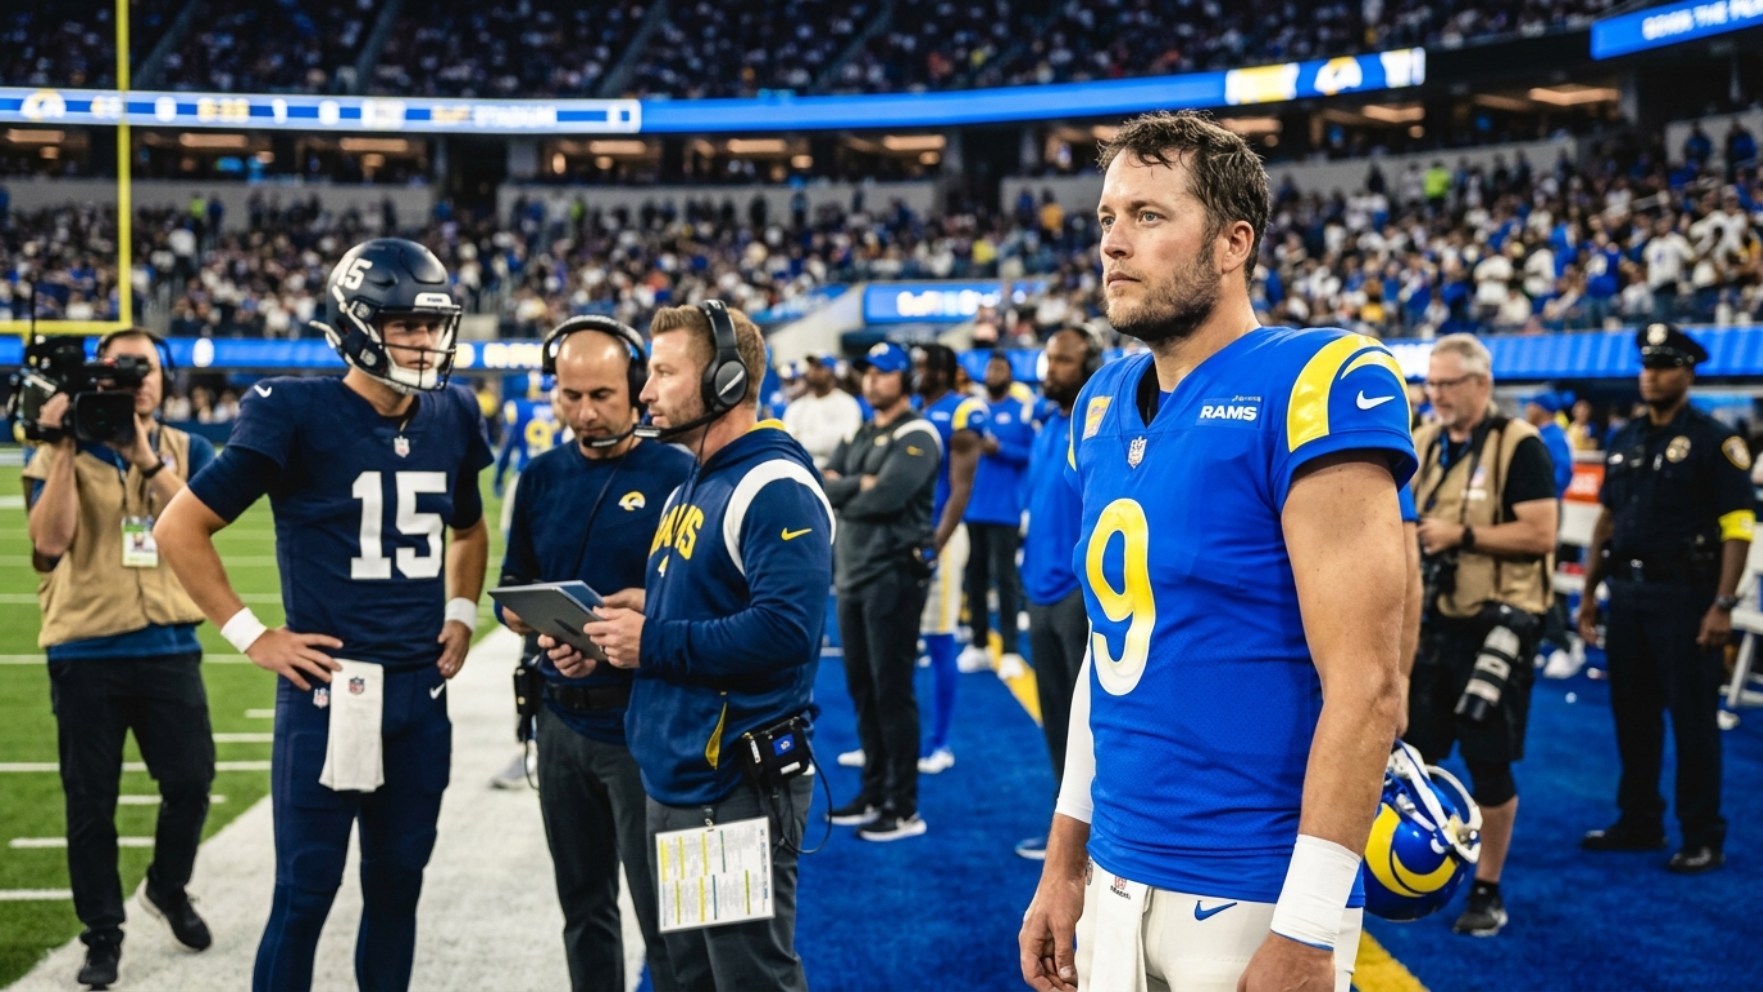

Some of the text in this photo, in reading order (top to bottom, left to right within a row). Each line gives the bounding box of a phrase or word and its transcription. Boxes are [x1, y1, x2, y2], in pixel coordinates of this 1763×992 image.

[1200, 405, 1257, 421] RAMS
[351, 471, 447, 579] 15
[1086, 498, 1156, 695] 9
